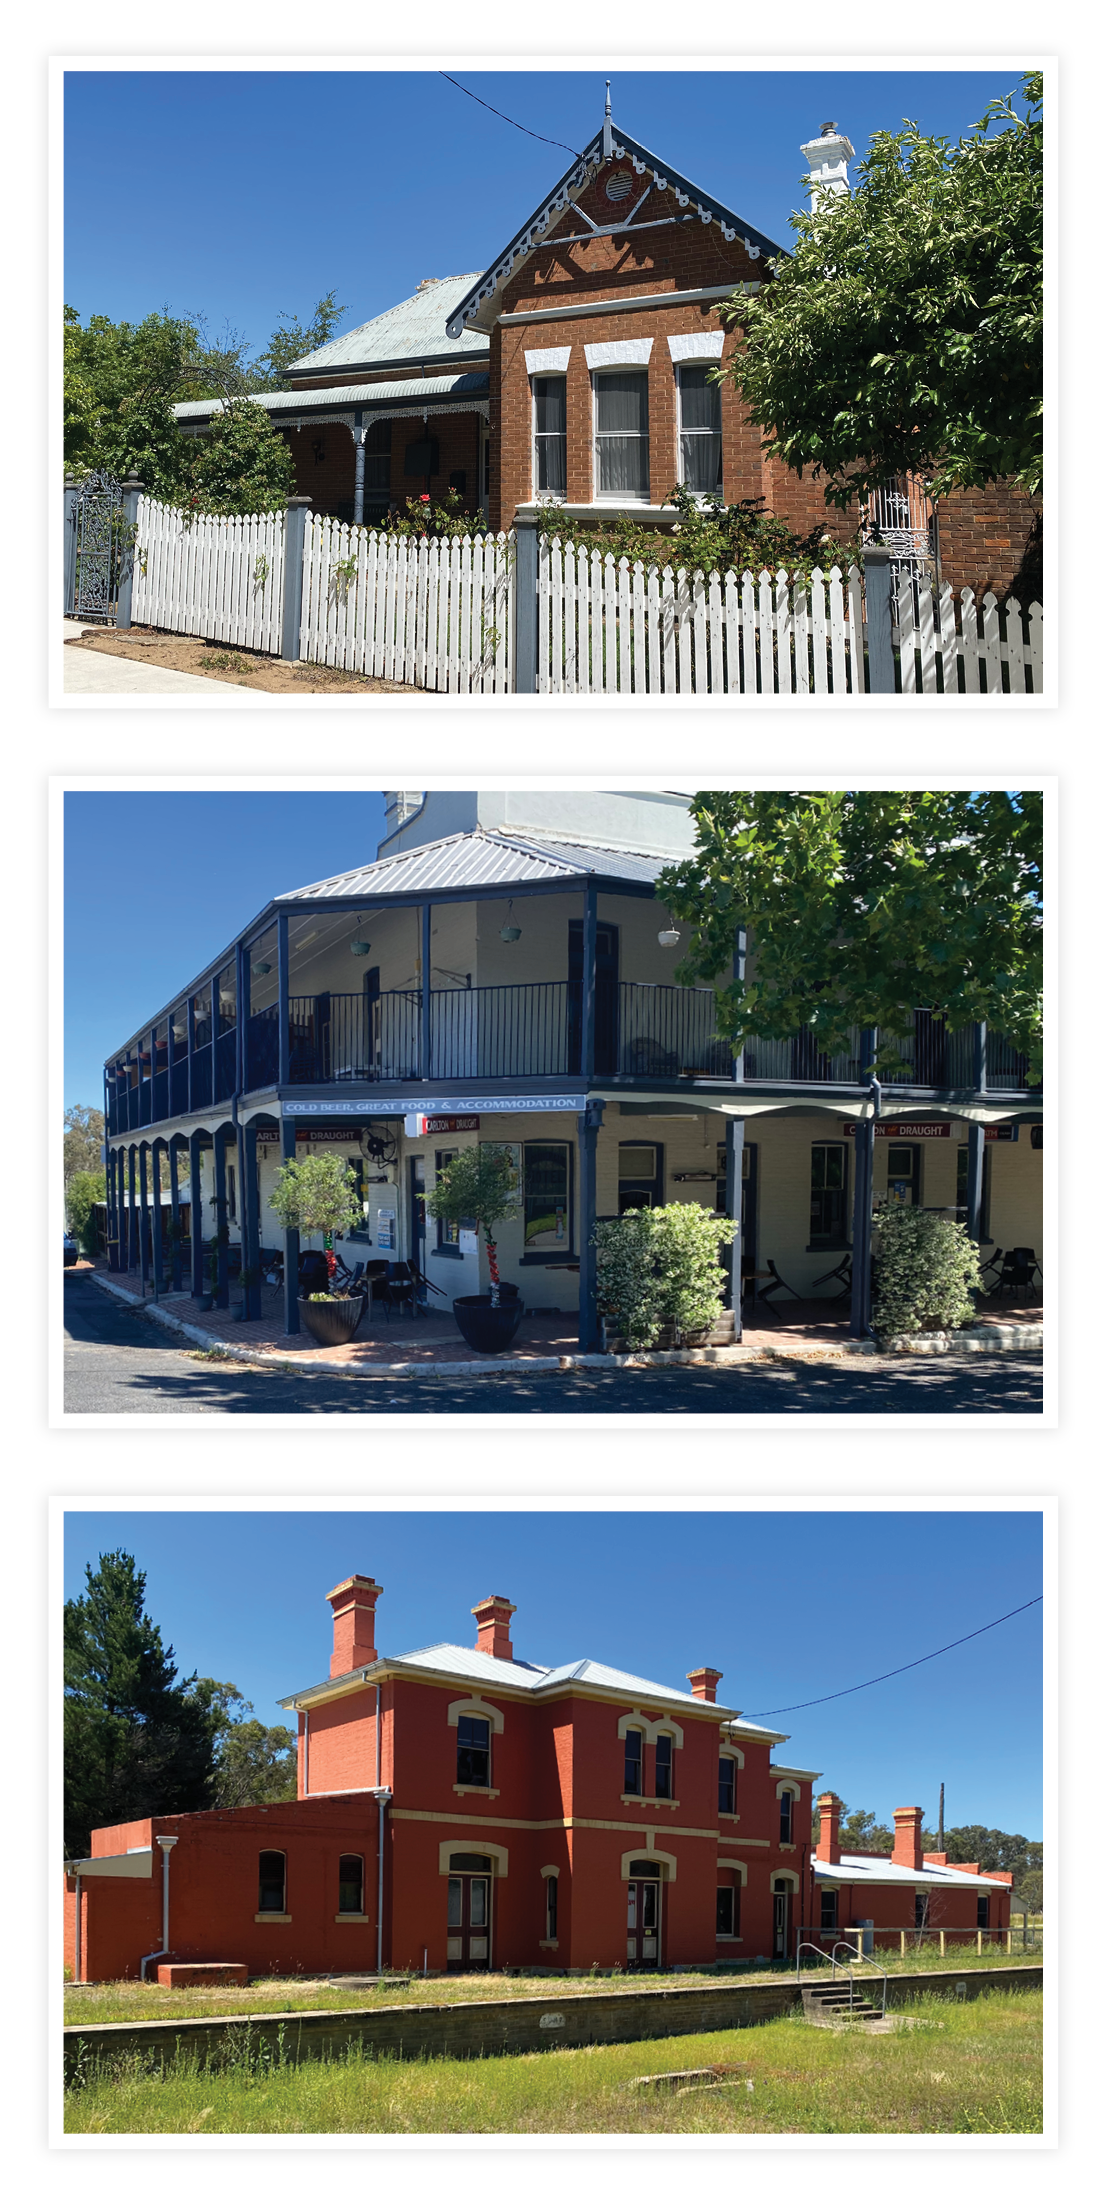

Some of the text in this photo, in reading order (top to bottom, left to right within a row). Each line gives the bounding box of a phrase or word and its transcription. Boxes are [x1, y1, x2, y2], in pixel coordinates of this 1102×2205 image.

[286, 1099, 577, 1112] COLD BEER, GREAT FOOD & ACCOMMODATION
[426, 1119, 477, 1131] CARLTON DRAUGHT
[310, 1132, 355, 1140] DRAUGHT
[899, 1126, 943, 1136] DRAUGHT
